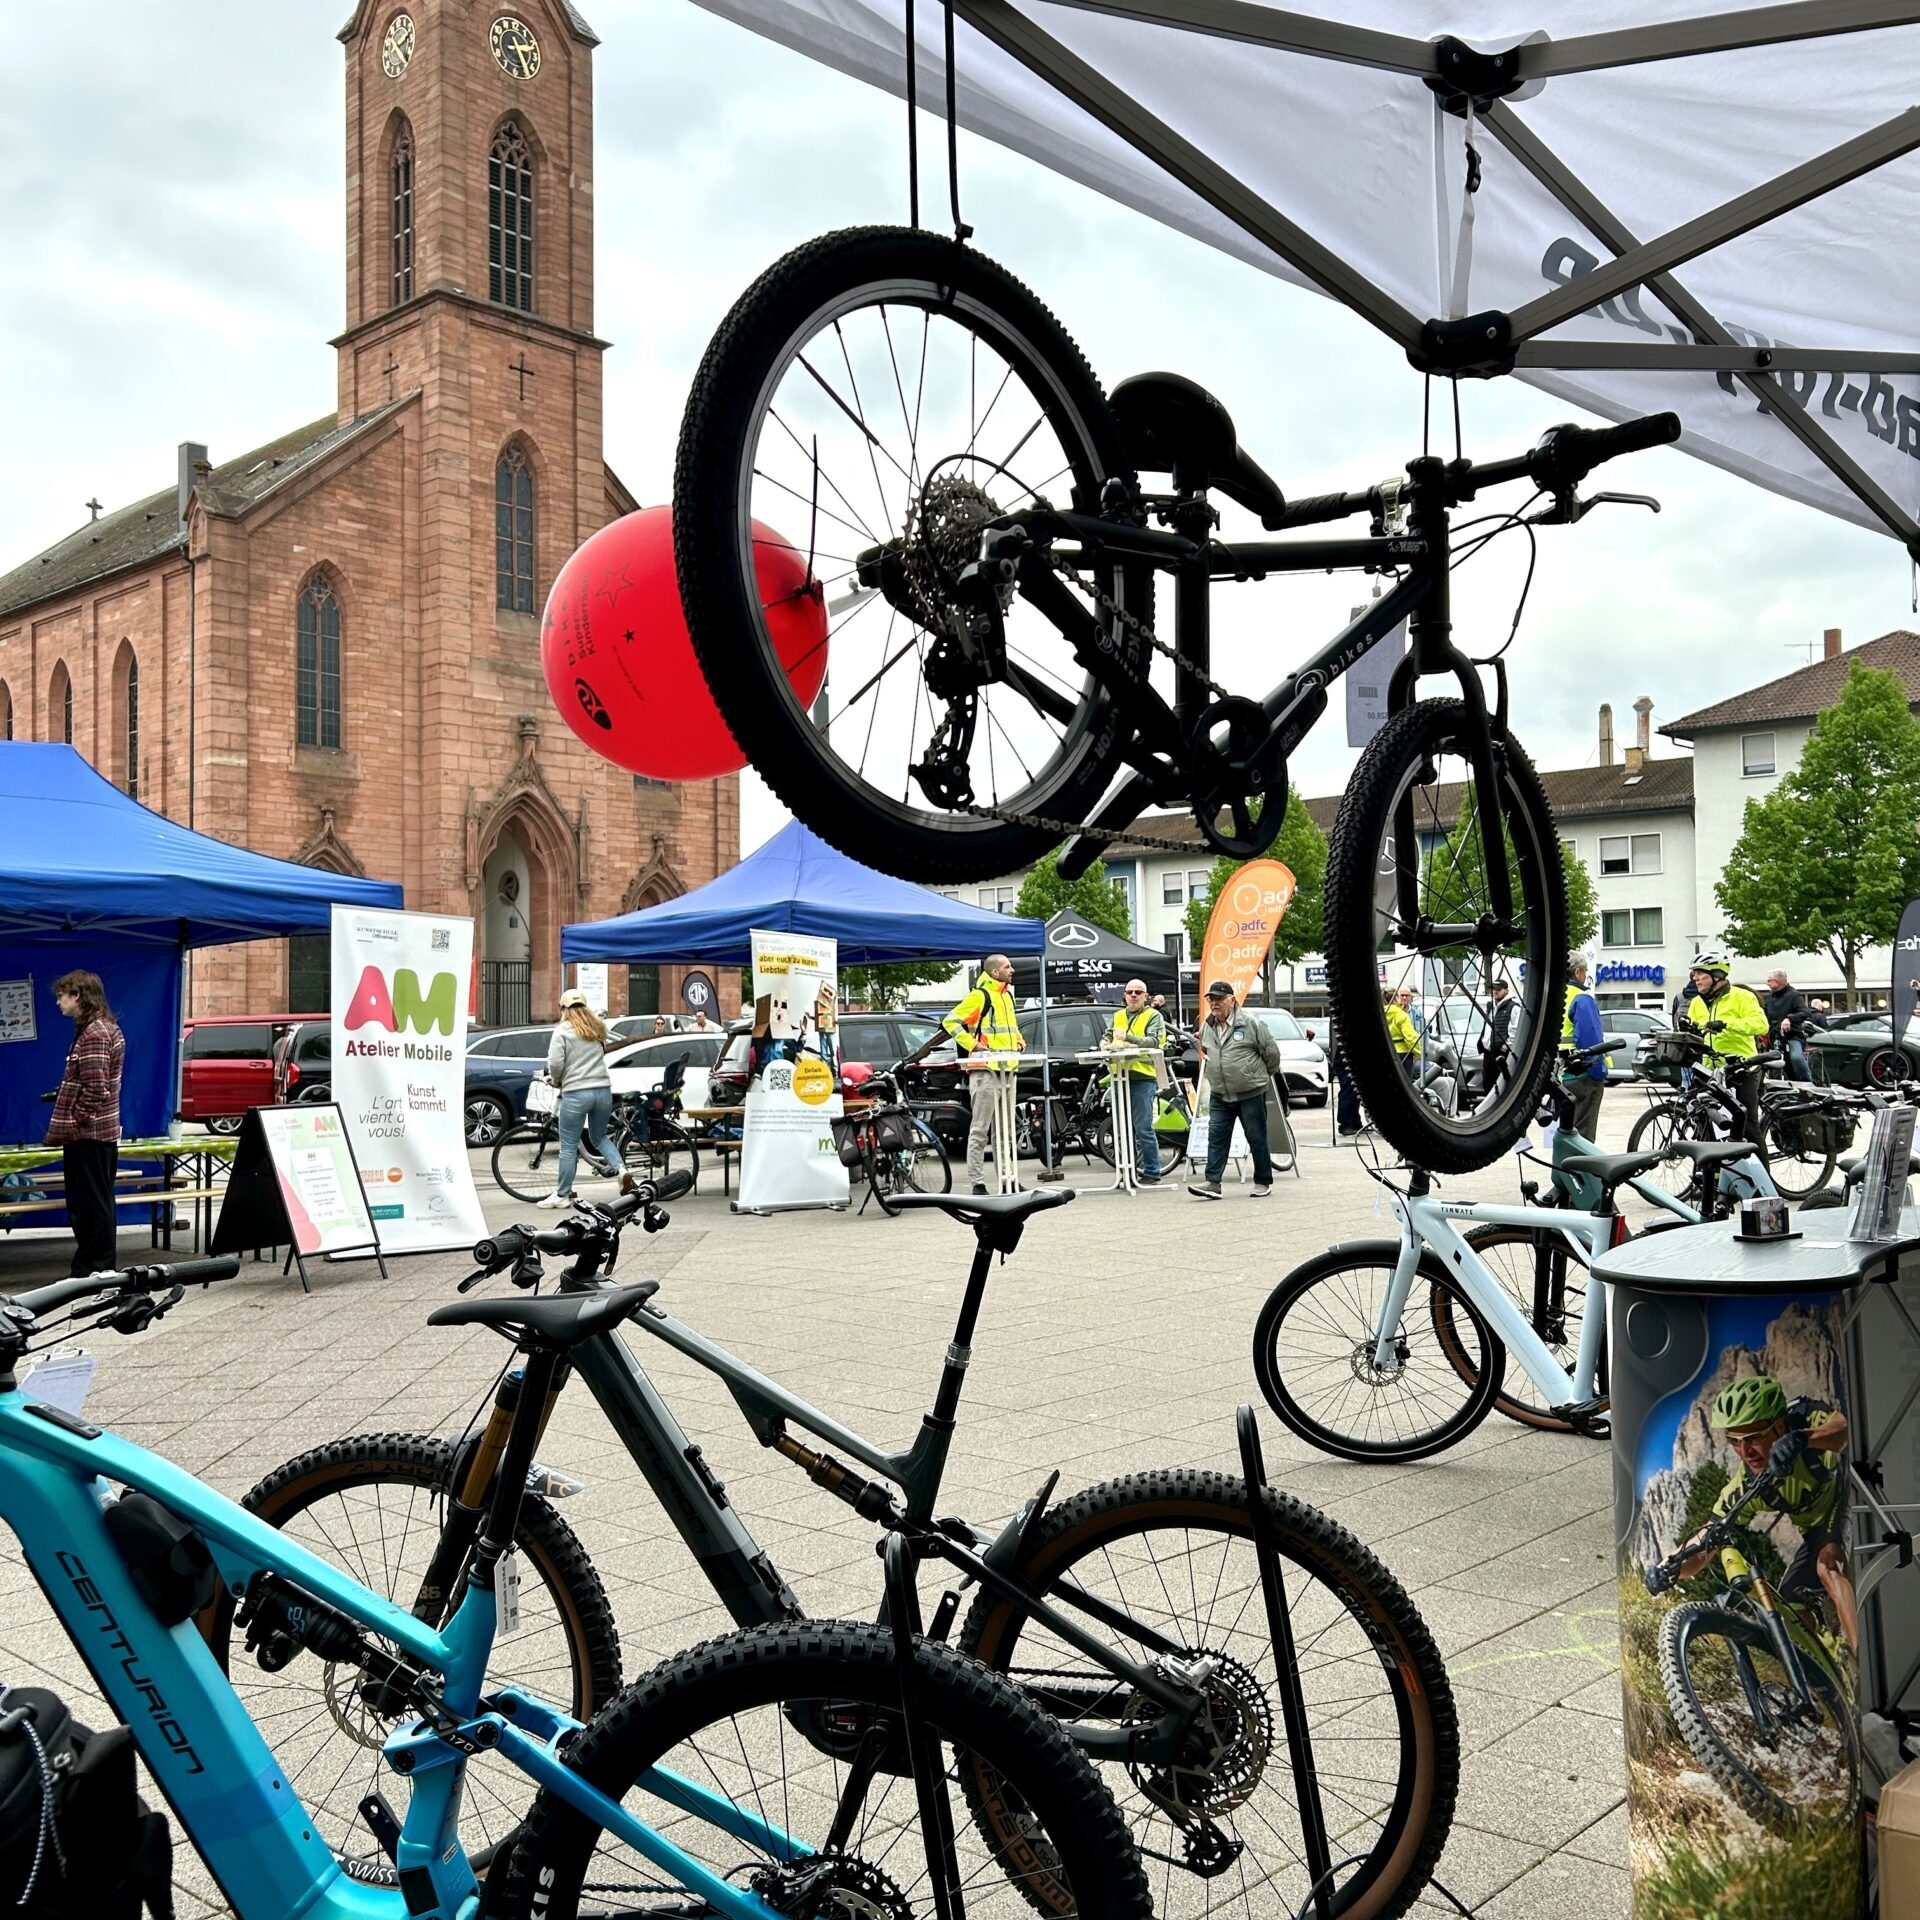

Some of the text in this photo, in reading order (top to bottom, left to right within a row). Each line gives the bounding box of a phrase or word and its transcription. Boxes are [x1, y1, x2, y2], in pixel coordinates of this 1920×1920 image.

[1328, 631, 1375, 678] bikes
[1241, 919, 1268, 931] adfc
[1232, 944, 1265, 959] adfc
[1078, 959, 1112, 973] S&G
[344, 965, 458, 1037] AM
[345, 1040, 453, 1062] Atelier Mobile
[407, 1083, 437, 1098] Kunst
[408, 1097, 447, 1112] kommt!
[358, 1110, 393, 1124] vient
[368, 1124, 405, 1138] vous!
[1441, 1206, 1474, 1215] TENWAYS
[1336, 1586, 1379, 1635] SWISS
[55, 1550, 205, 1776] CENTURION
[448, 1733, 475, 1752] 170
[347, 1859, 397, 1885] SWISS
